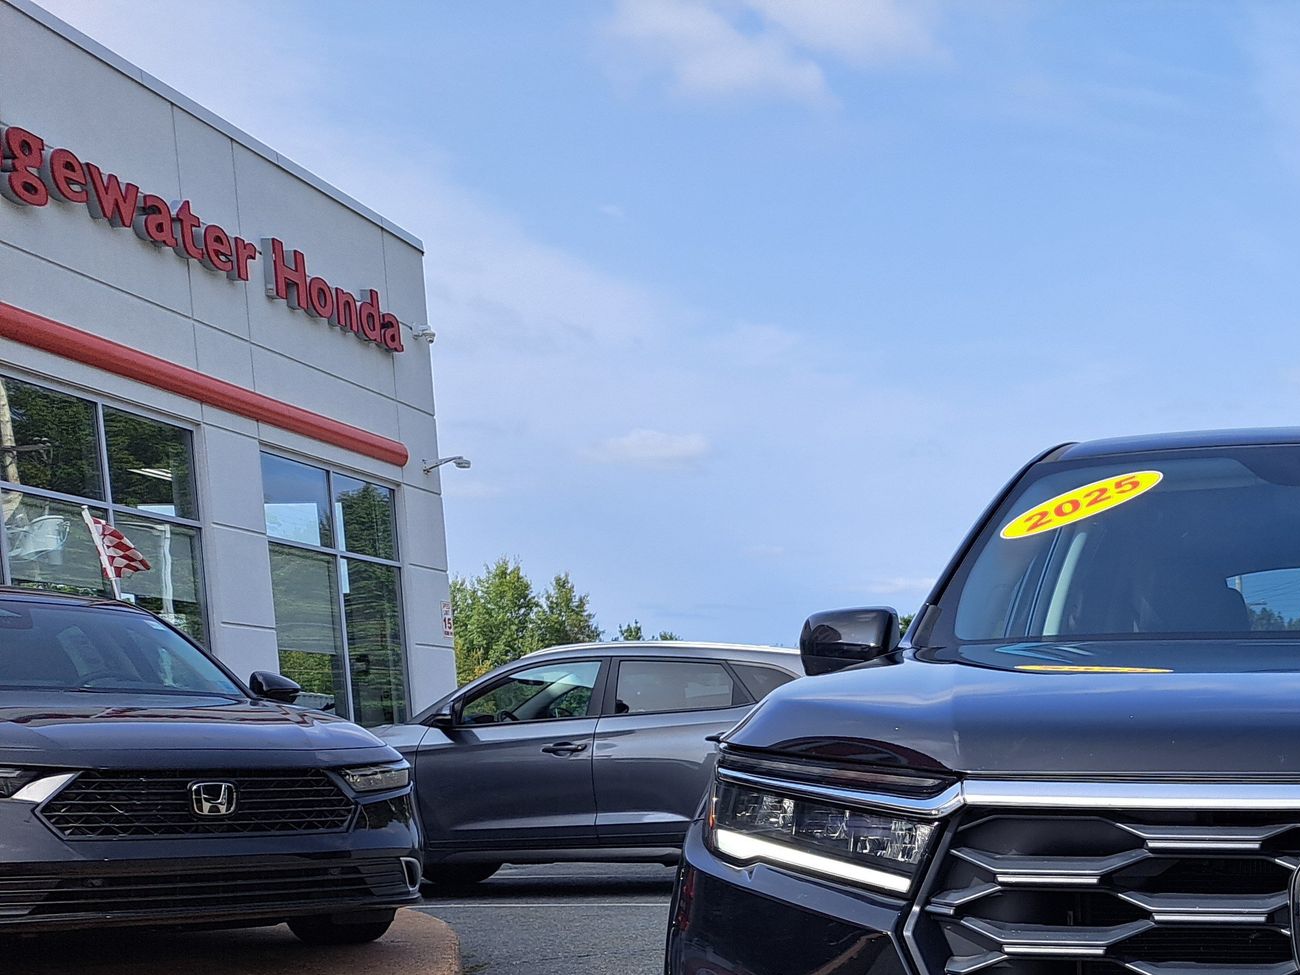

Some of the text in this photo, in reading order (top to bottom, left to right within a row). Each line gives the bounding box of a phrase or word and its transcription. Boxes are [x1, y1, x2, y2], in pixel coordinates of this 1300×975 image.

[0, 126, 405, 353] gewater Honda
[1023, 475, 1141, 532] 2025
[443, 616, 453, 630] 15
